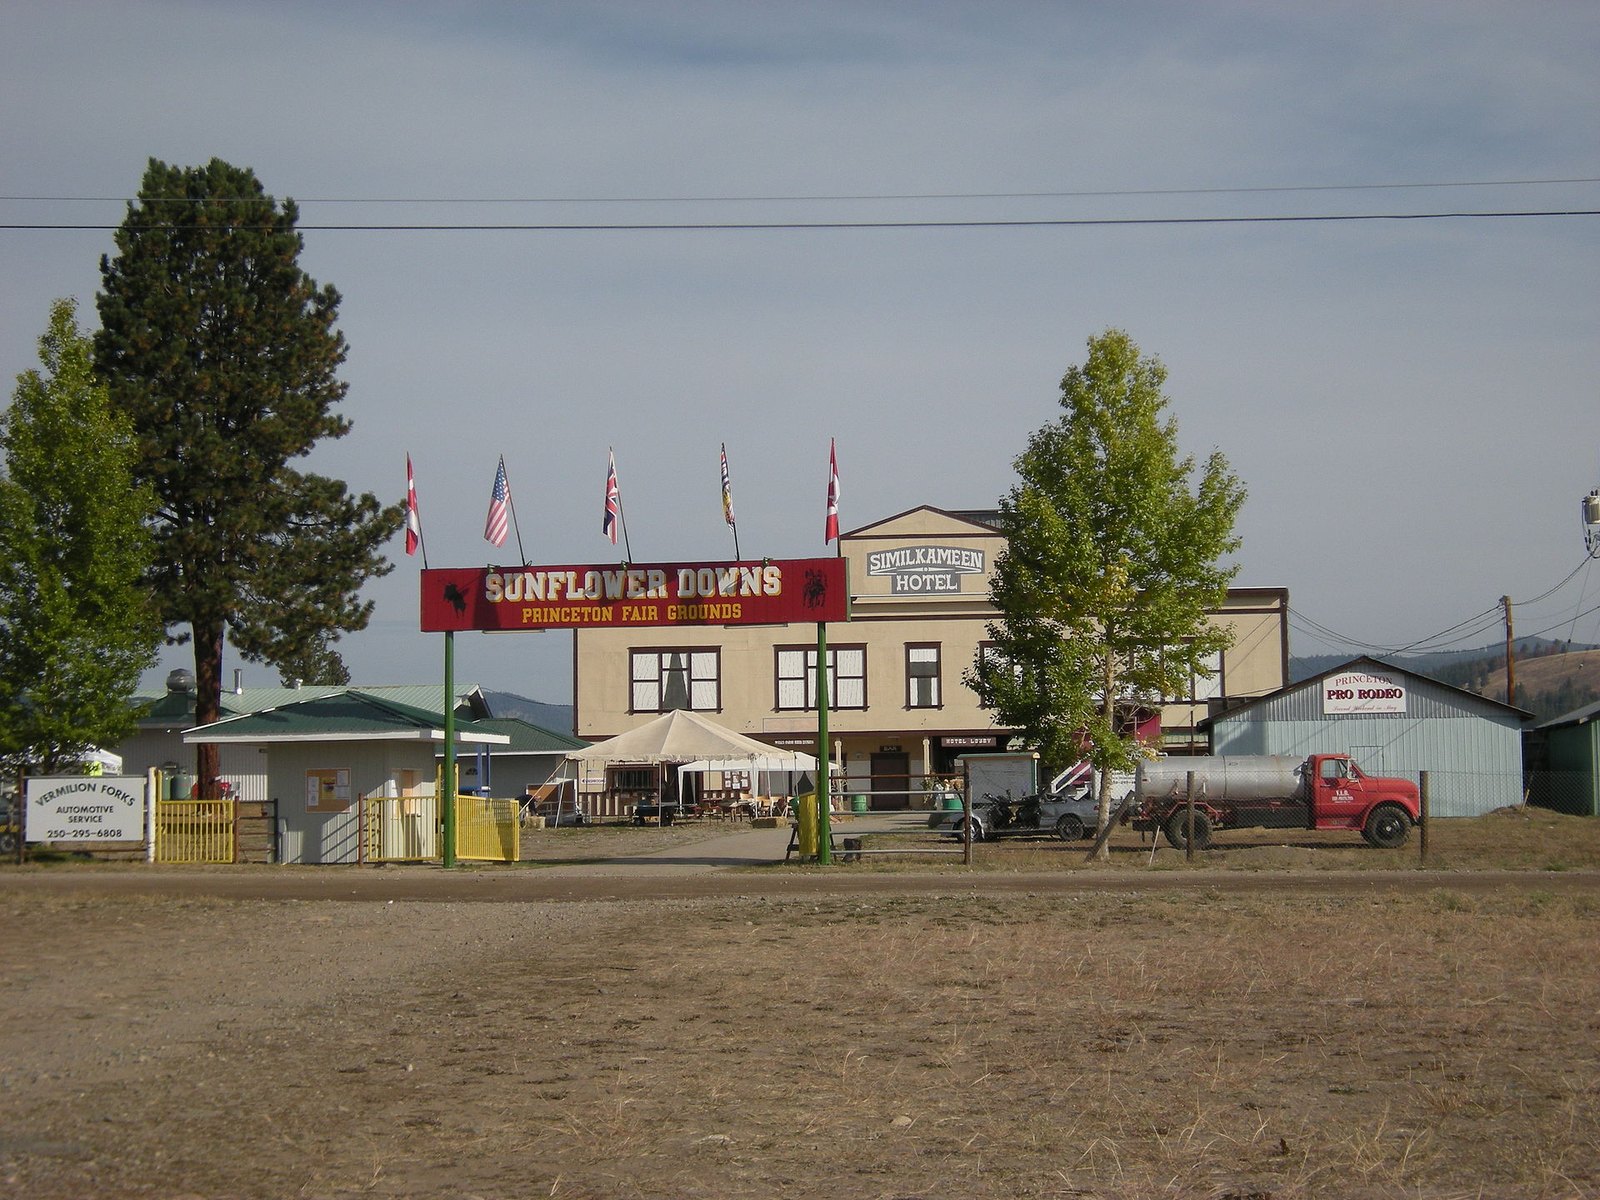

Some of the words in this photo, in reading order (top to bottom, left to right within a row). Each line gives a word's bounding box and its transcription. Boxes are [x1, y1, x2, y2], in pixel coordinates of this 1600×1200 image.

[870, 548, 983, 571] SIMILKAMEEN
[485, 569, 669, 603] SUNFLOWER
[677, 565, 782, 599] DOWNS
[896, 574, 958, 591] HOTEL
[522, 606, 613, 623] PRINCETON
[622, 605, 658, 621] FAIR
[667, 603, 742, 620] GROUNDS
[1335, 675, 1393, 686] PRINCETON
[1327, 689, 1354, 700] PRO
[1358, 688, 1403, 699] RODEO
[35, 783, 97, 807] VERMILION
[101, 784, 136, 807] FORKS
[56, 805, 114, 814] AUTOMOTIVE
[68, 815, 103, 823] SERVICE
[47, 829, 122, 838] 250-295-6808
